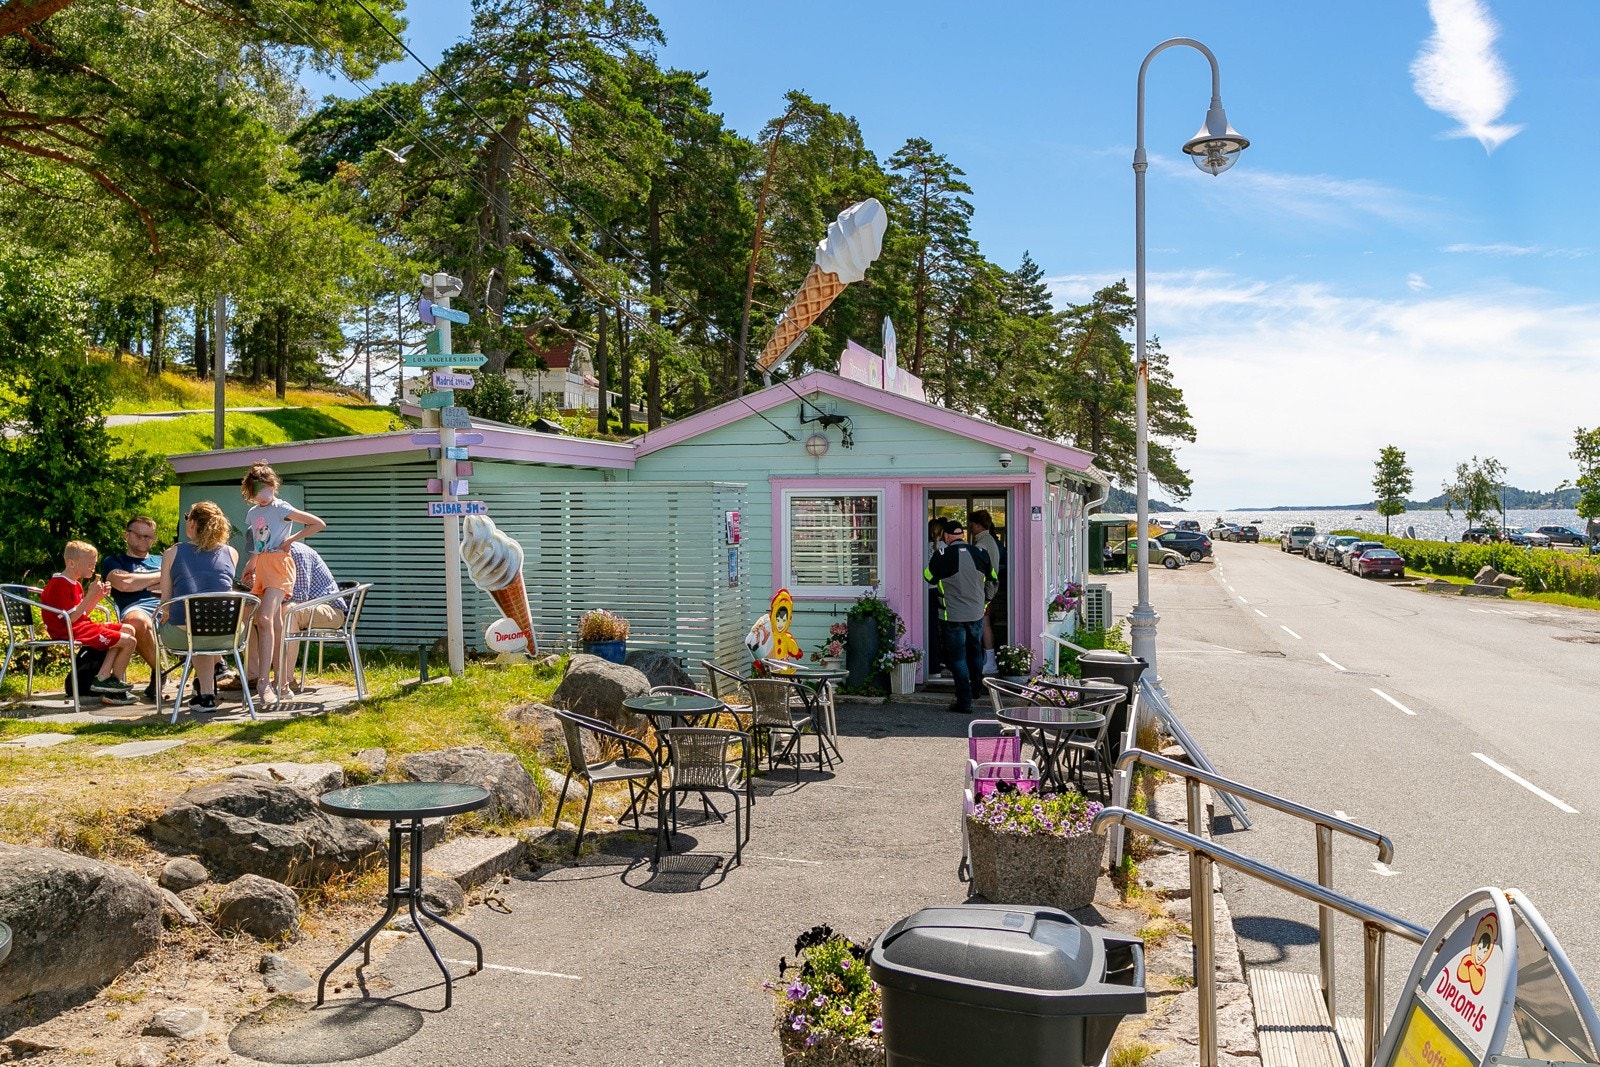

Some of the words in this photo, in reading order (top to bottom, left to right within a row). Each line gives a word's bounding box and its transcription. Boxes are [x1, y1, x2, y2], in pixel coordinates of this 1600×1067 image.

[436, 375, 454, 386] Madrid
[445, 407, 465, 418] IBIZA
[432, 503, 462, 514] ISIBAR
